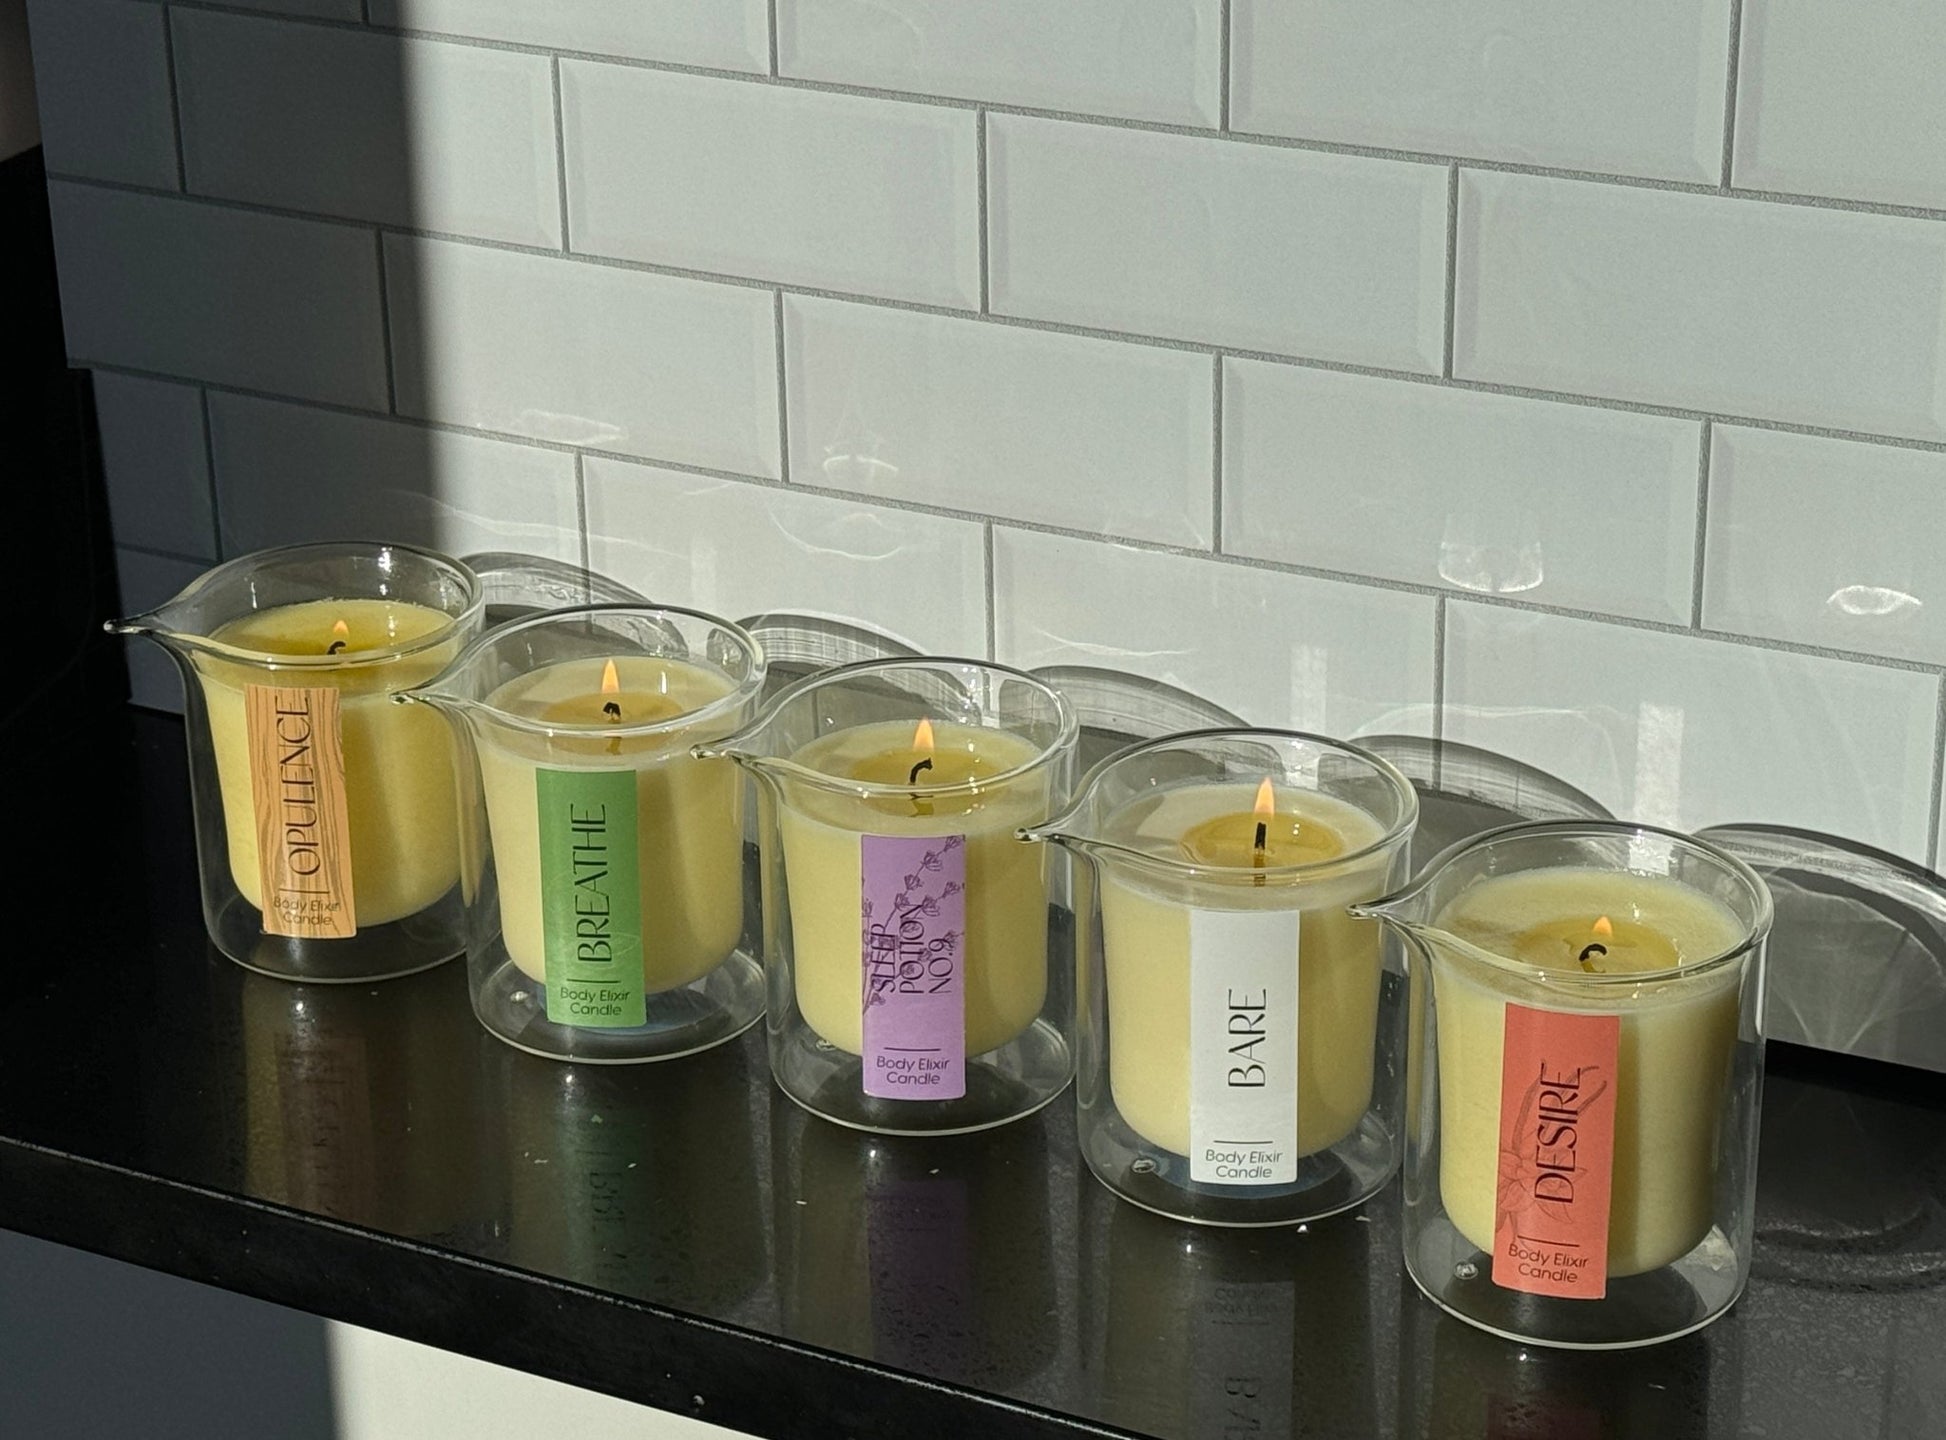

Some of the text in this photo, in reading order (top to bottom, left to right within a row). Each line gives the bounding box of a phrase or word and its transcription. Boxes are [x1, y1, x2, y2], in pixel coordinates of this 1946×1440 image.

[274, 695, 321, 876] OPULENCE
[570, 803, 613, 962] BREATHE
[273, 896, 341, 912] Body Elixir
[283, 910, 333, 926] Candle
[870, 923, 896, 993] SLEEP
[899, 904, 925, 994] POTION
[928, 938, 954, 993] NO.9
[560, 986, 631, 1002] Body Elixir
[569, 1002, 622, 1016] Candle
[1228, 988, 1267, 1087] BARE
[876, 1055, 950, 1071] Body Elixir
[886, 1071, 940, 1085] Candle
[1534, 1062, 1581, 1204] DESIRE
[1205, 1149, 1283, 1166] Body Elixir
[1215, 1165, 1273, 1179] Candle
[1508, 1244, 1589, 1269] Body Elixir
[1518, 1264, 1578, 1284] Candle
